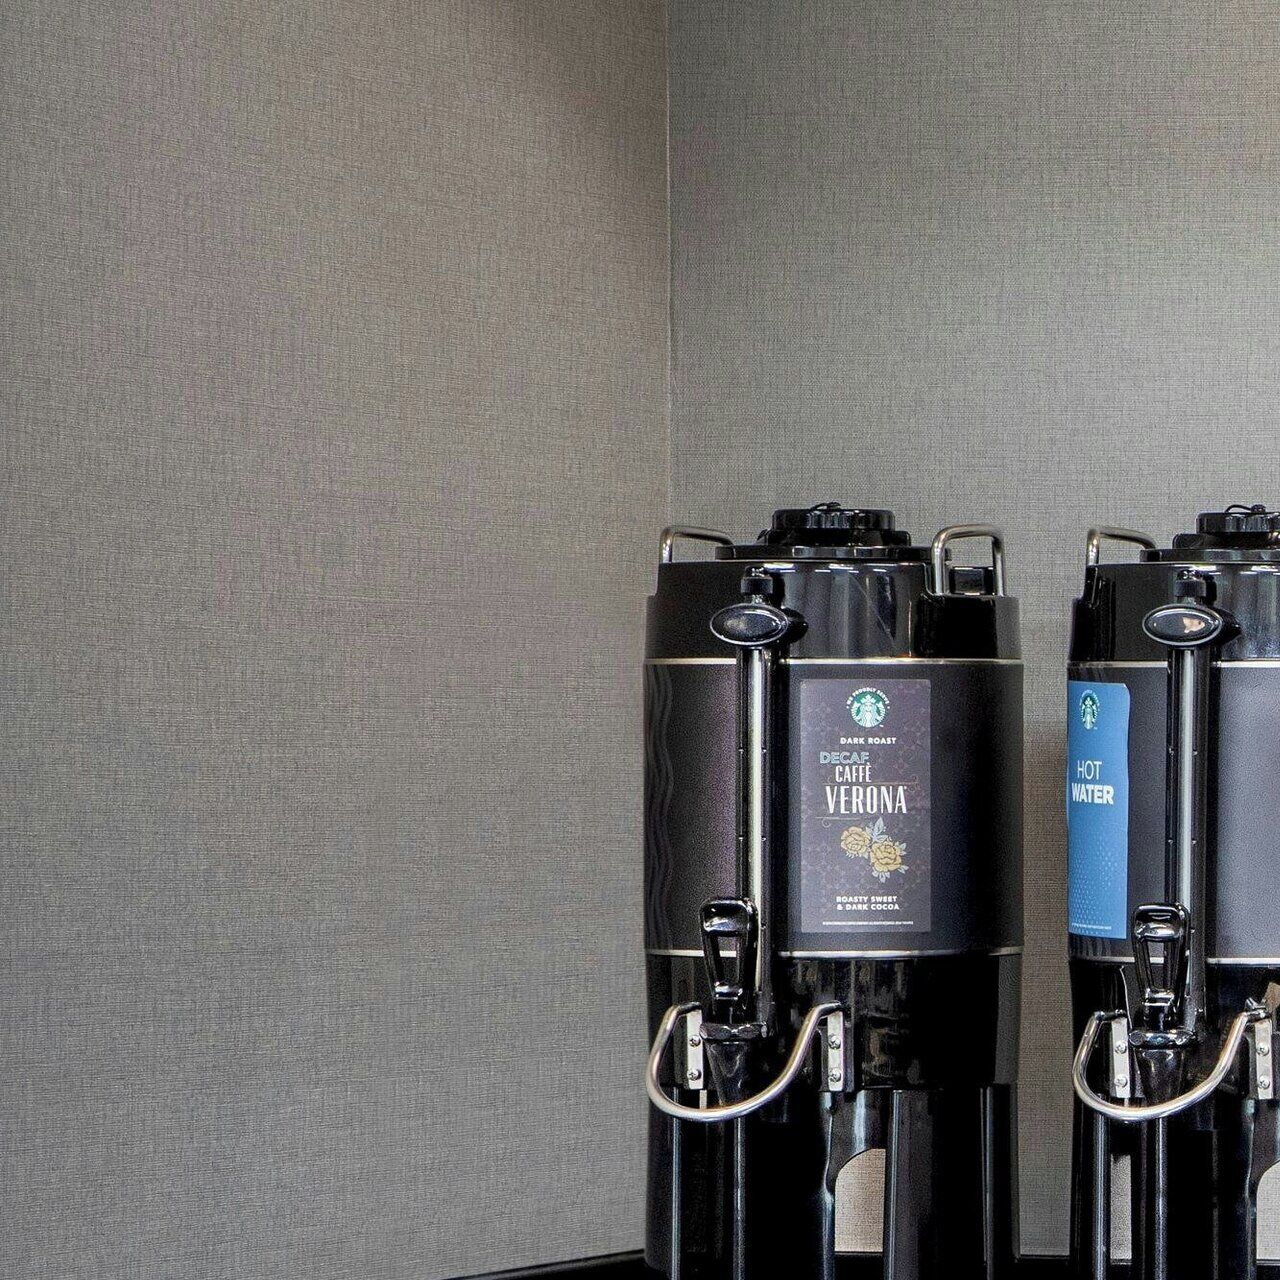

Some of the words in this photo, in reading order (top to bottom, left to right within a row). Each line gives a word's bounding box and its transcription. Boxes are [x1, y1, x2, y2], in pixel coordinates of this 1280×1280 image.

[840, 737, 865, 745] DARK
[867, 737, 897, 745] ROAST
[819, 751, 870, 764] DECAF
[835, 762, 872, 783] CAFFÈ
[1077, 760, 1103, 780] HOT
[825, 785, 907, 814] VERONA
[1071, 782, 1115, 805] WATER
[836, 895, 869, 903] ROASTY
[870, 895, 898, 903] SWEET
[836, 903, 844, 911] &
[845, 903, 869, 911] DARK
[870, 903, 900, 911] COCOA
